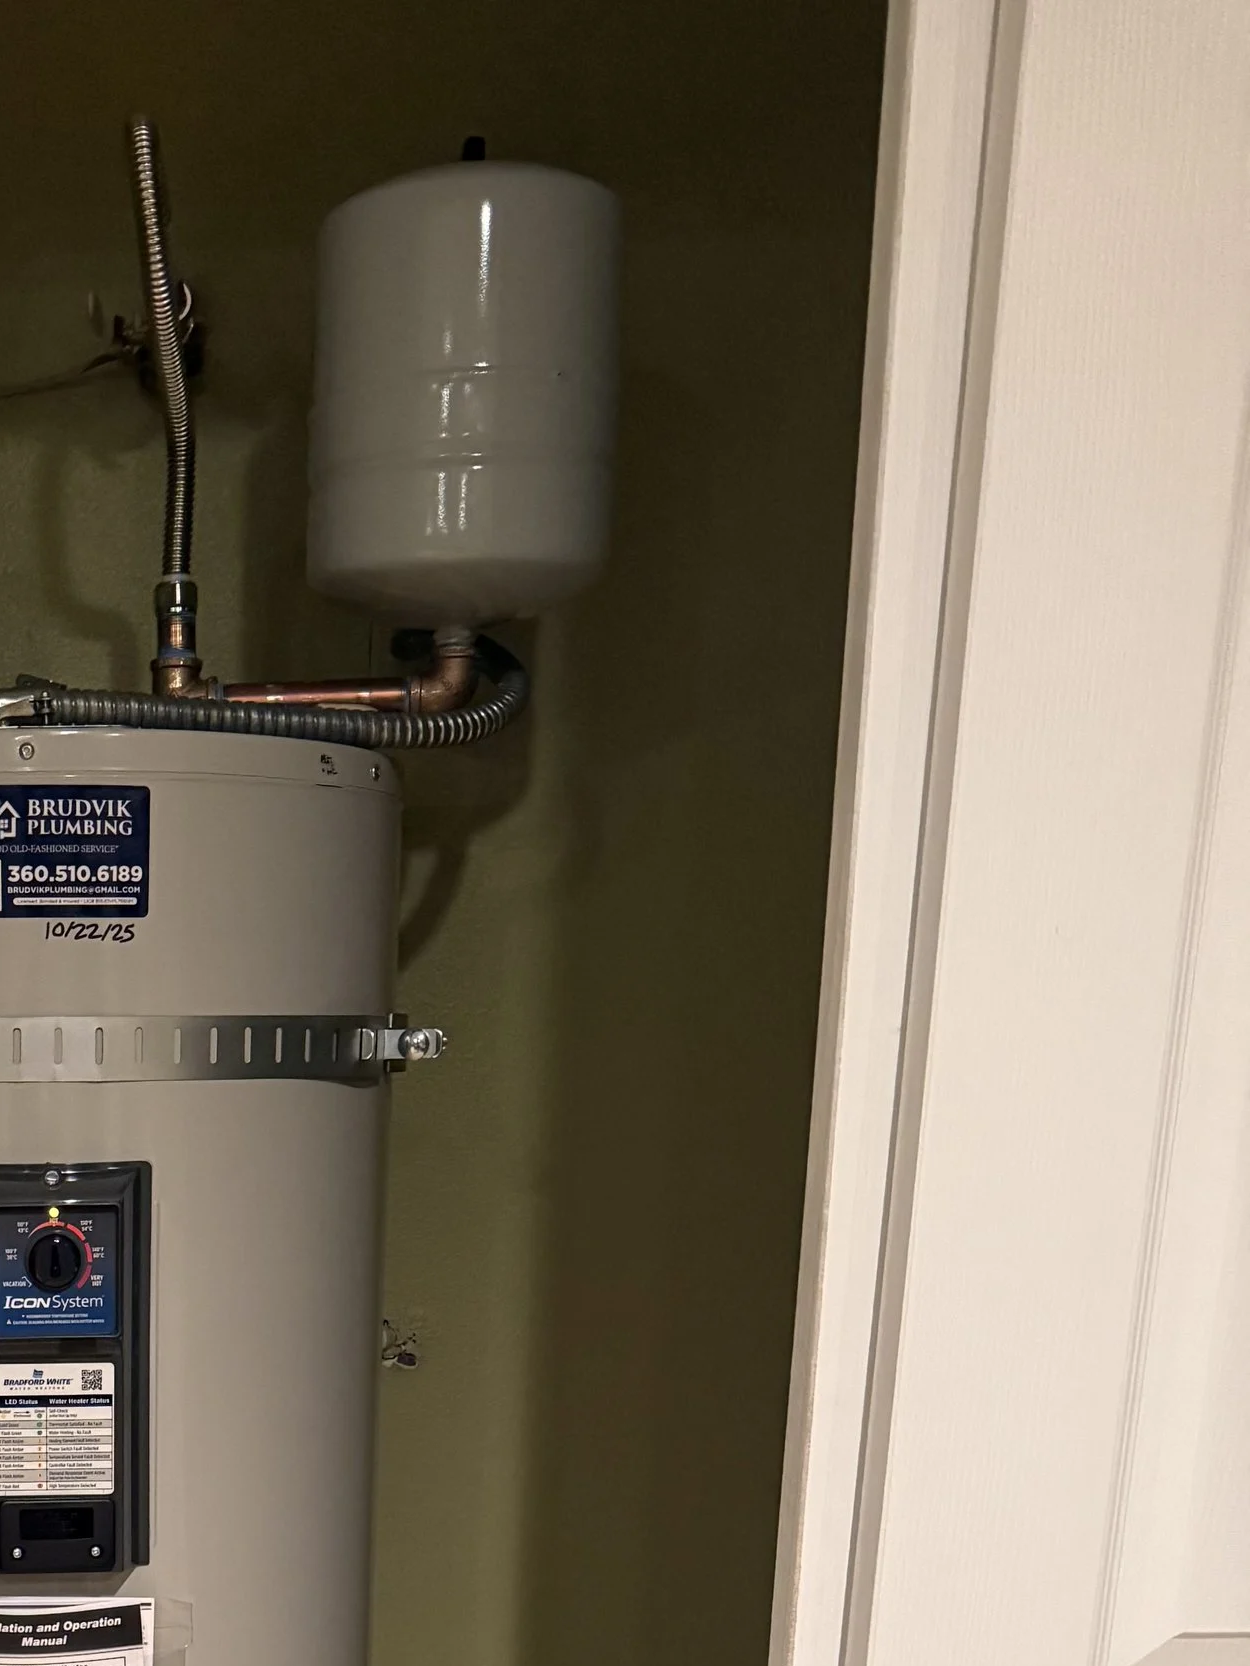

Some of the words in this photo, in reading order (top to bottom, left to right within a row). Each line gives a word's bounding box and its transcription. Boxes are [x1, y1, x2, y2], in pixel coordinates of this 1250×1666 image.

[27, 798, 133, 818] BRUDVIK
[27, 819, 133, 836] PLUMBING
[10, 844, 80, 854] OLD-FASHIONED
[7, 864, 143, 882] 360.510.6189
[7, 886, 141, 894] BRUDVIKPLUMBING@GMAIL.COM
[45, 921, 136, 943] 10/22/25
[3, 1378, 45, 1386] BRADFORD
[46, 1378, 71, 1386] WHITE
[36, 1622, 60, 1633] and
[63, 1616, 122, 1633] Operation
[21, 1635, 68, 1647] Manual
